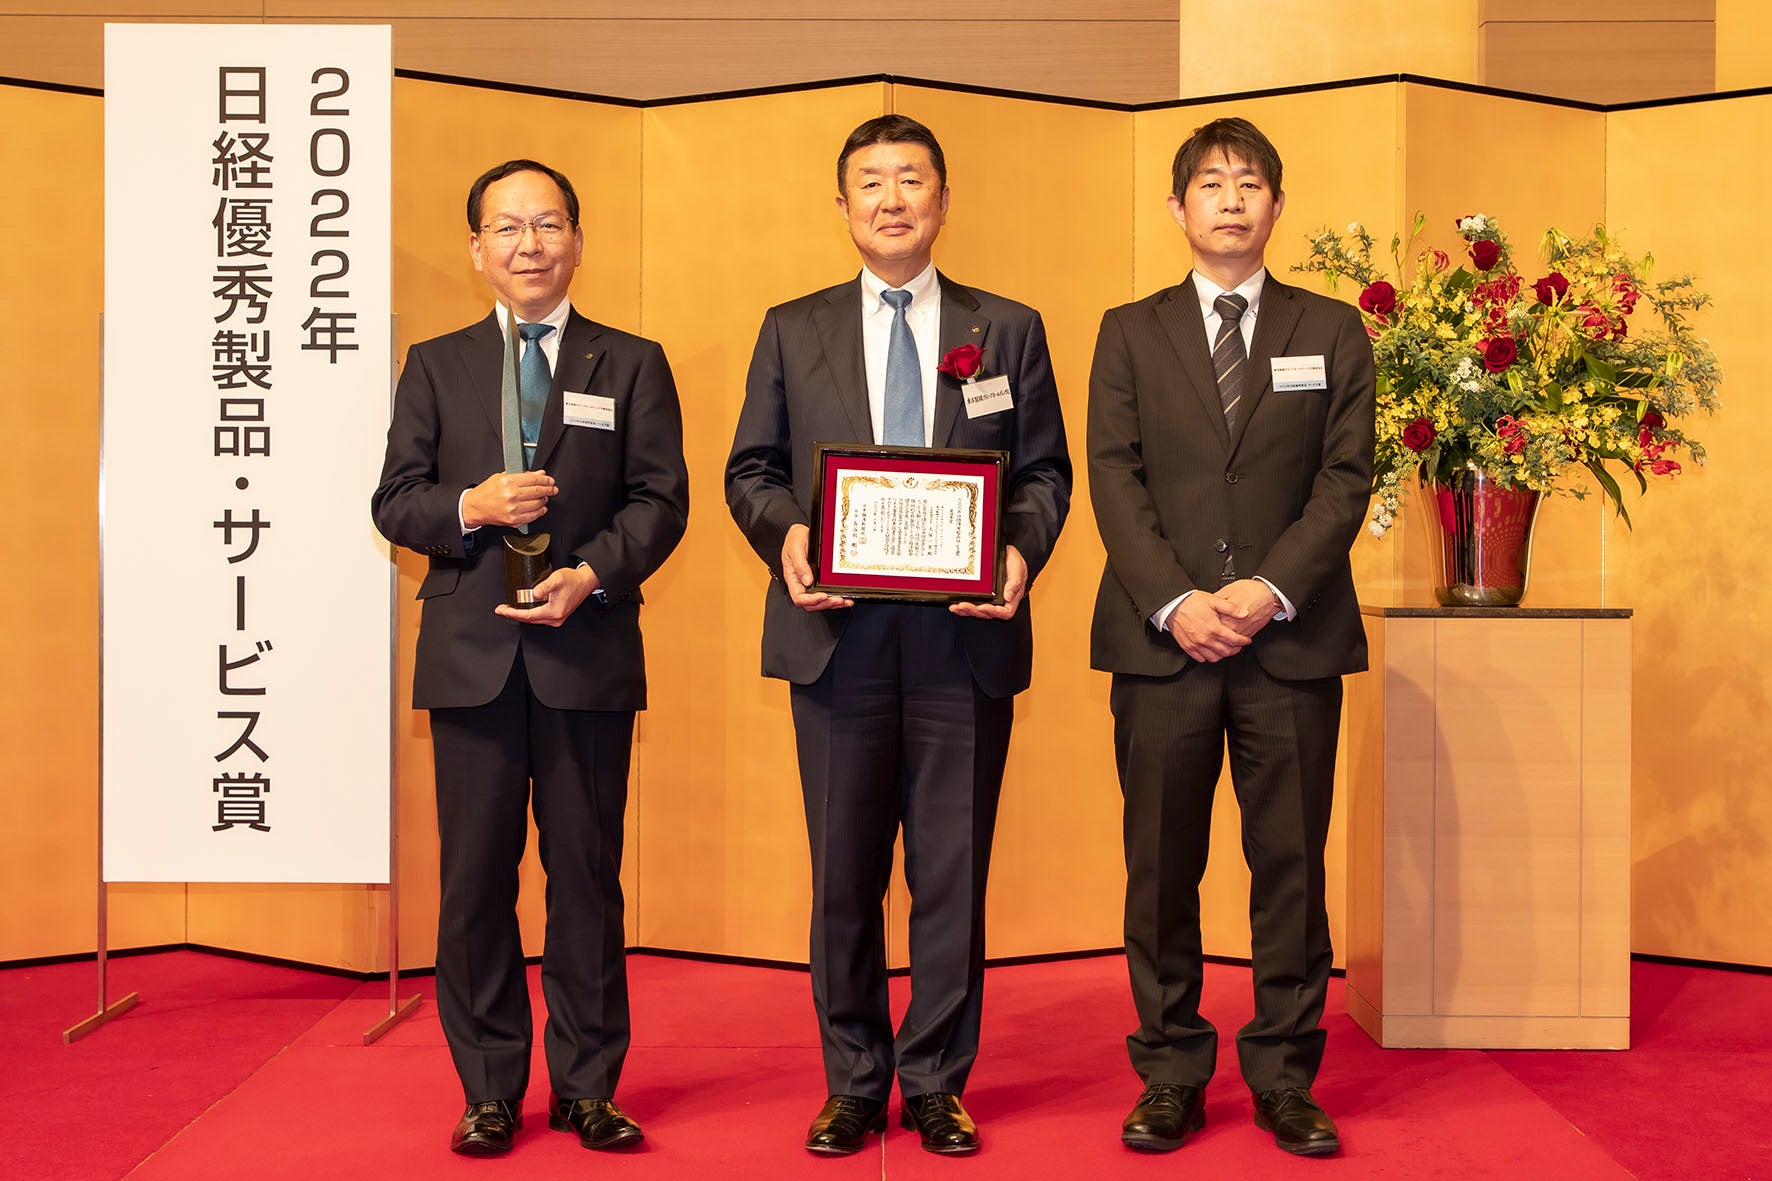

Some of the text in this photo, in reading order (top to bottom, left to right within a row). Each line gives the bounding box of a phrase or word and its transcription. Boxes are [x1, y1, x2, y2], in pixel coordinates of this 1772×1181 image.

[212, 66, 273, 833] 日経優秀製品・サービス賞
[301, 67, 359, 365] 2022年
